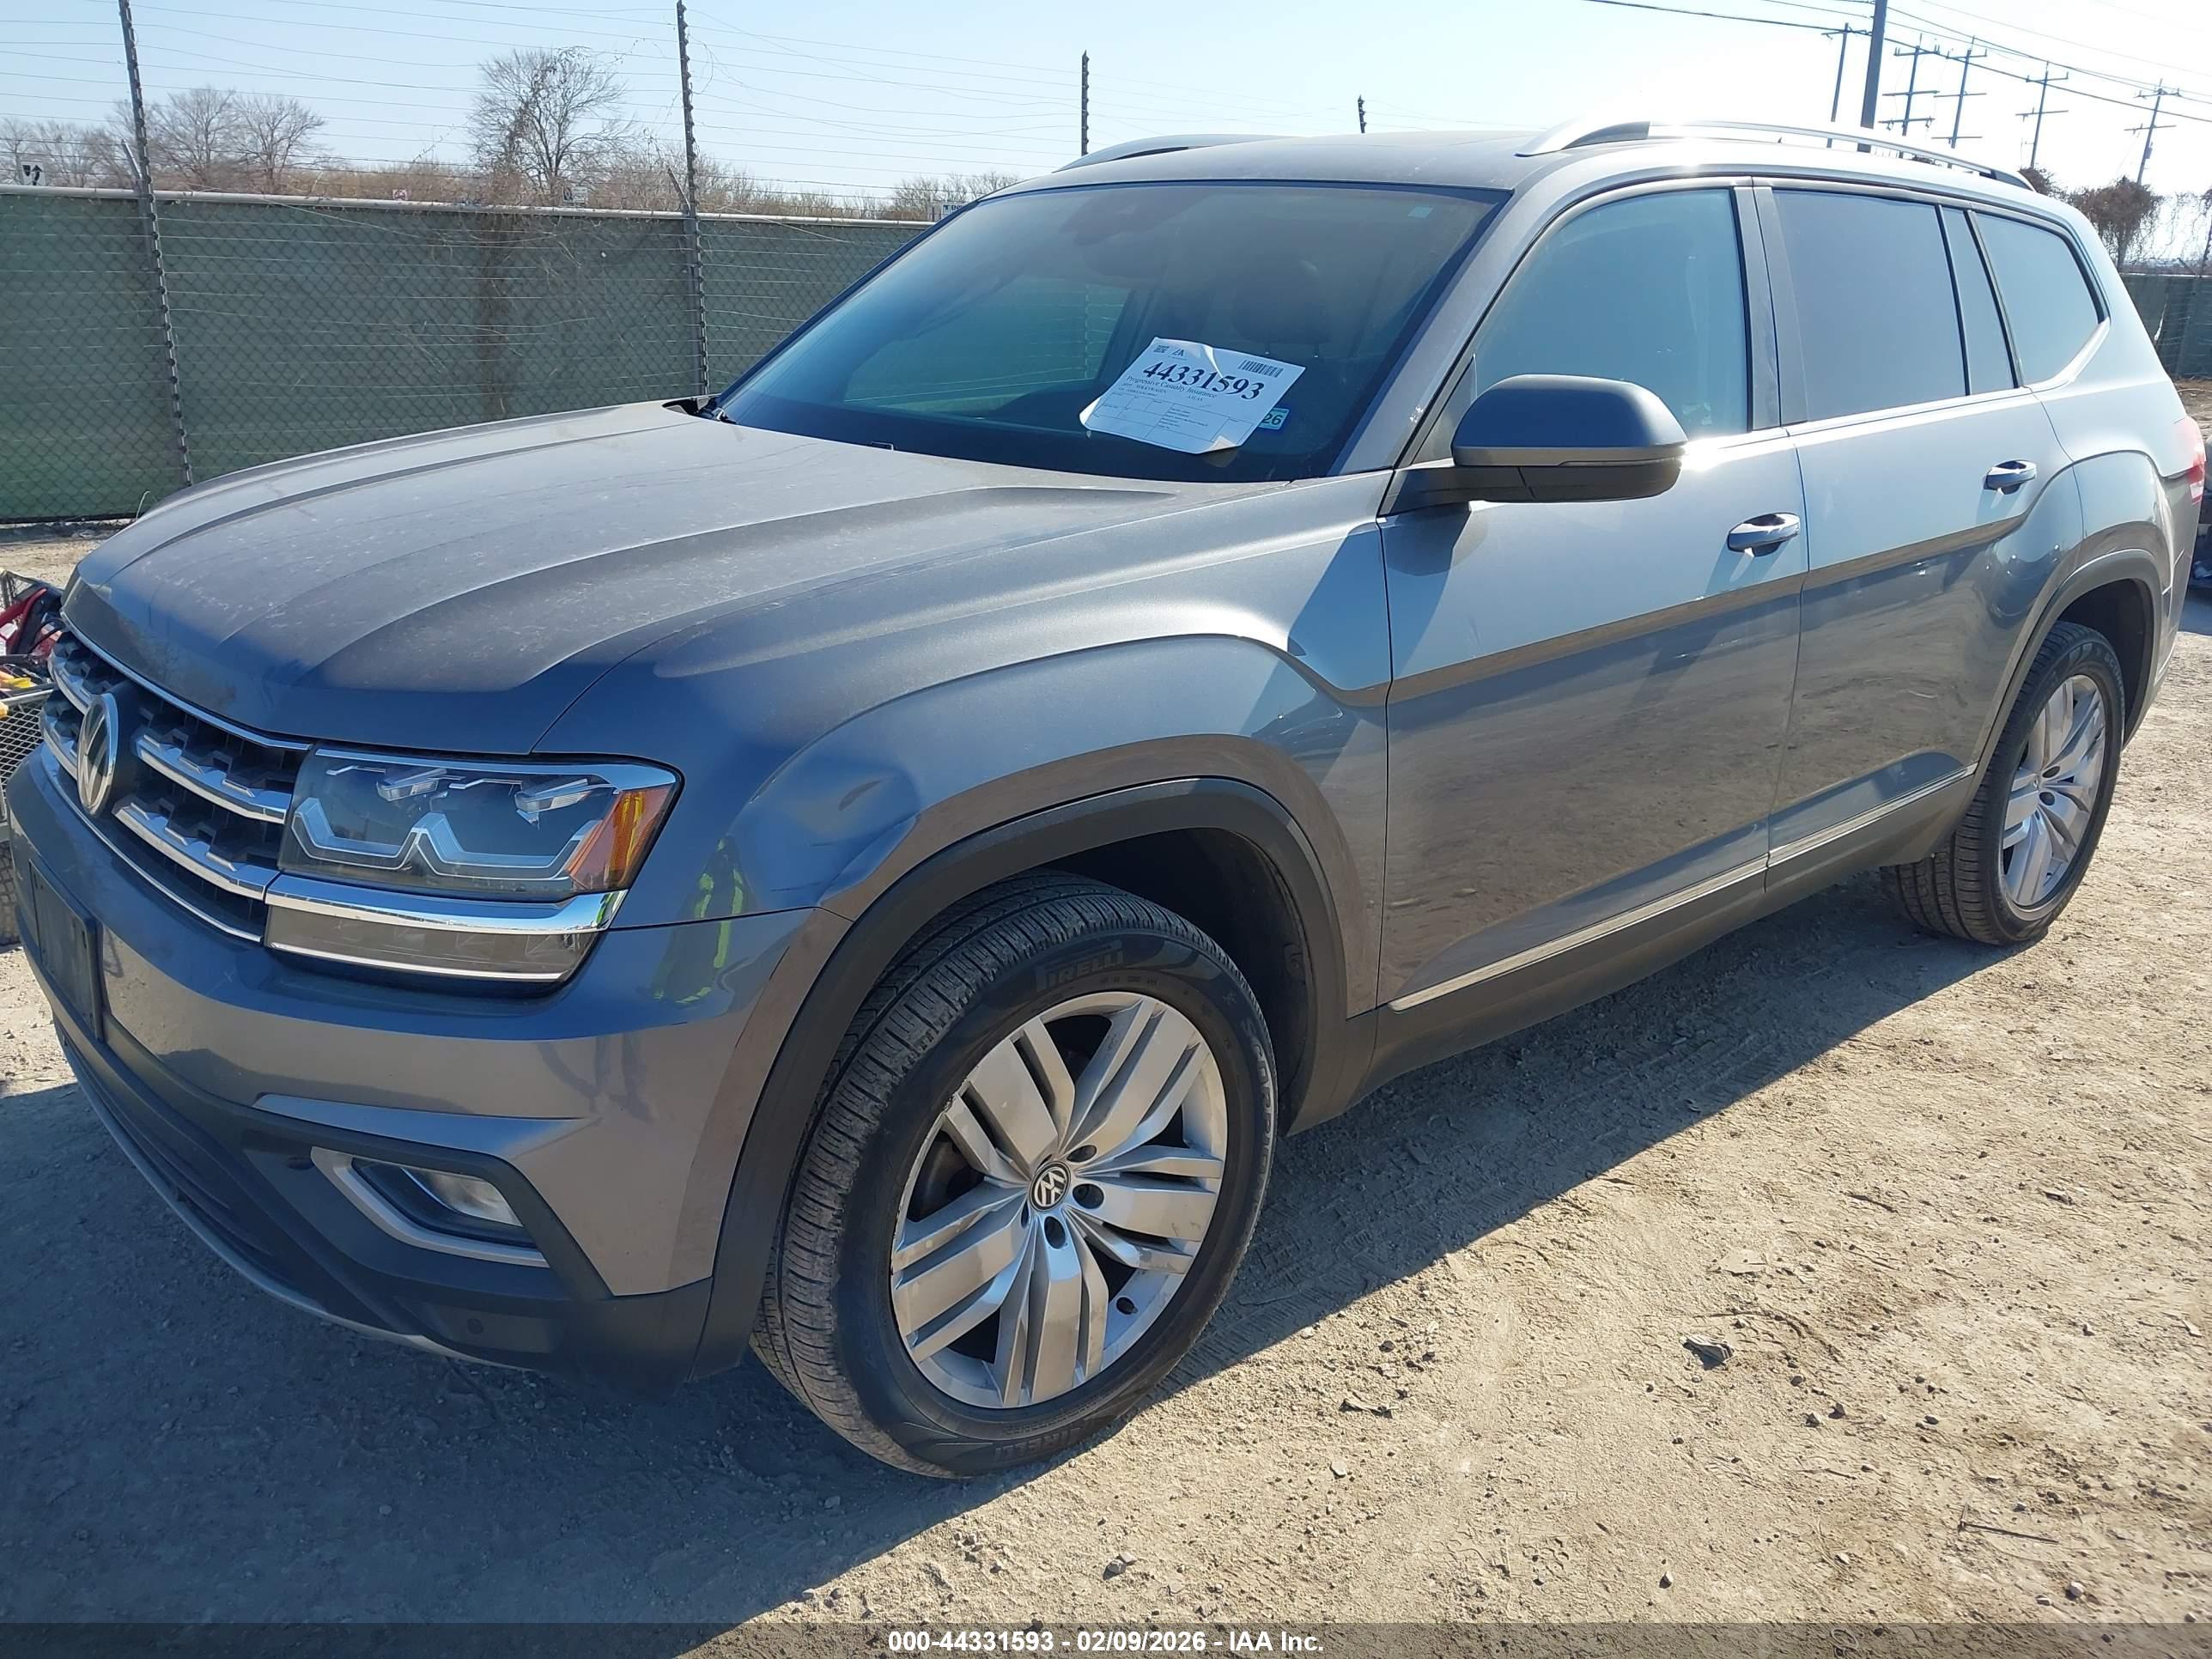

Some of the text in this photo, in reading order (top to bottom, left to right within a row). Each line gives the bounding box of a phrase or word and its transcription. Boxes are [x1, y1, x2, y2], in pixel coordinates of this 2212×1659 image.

[1126, 375, 1162, 386] Progressive
[1160, 381, 1186, 392] Casualty
[1187, 386, 1218, 399] Insurance
[1143, 362, 1265, 400] 44331593
[1262, 413, 1283, 425] 26
